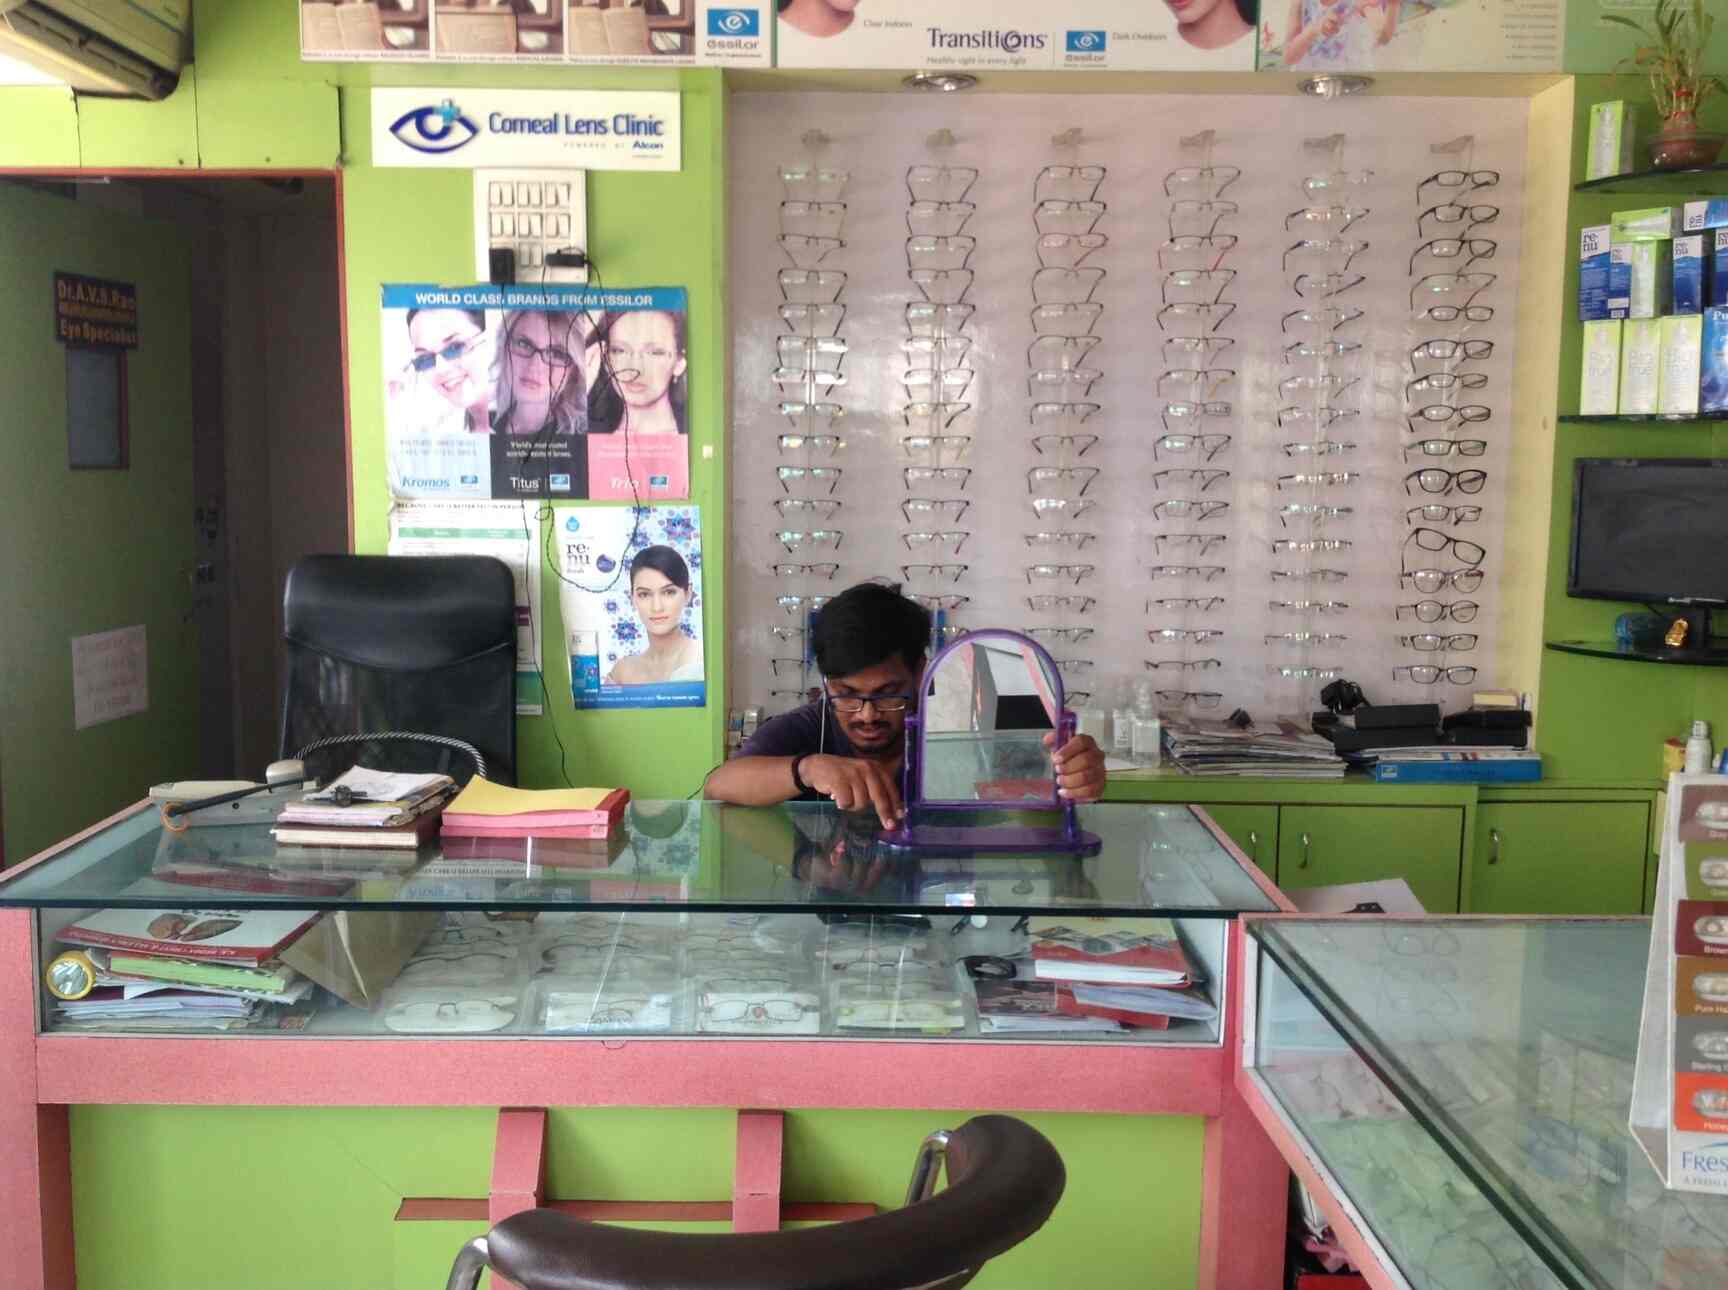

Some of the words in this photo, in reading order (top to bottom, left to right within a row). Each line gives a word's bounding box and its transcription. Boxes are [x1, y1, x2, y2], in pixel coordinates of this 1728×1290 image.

[926, 27, 1046, 53] Transitions
[489, 112, 559, 134] Corneal
[564, 113, 608, 135] Lens
[612, 113, 664, 136] Clinic
[415, 293, 461, 305] WORLD
[507, 293, 559, 306] BRANDS
[509, 476, 539, 489] Titus
